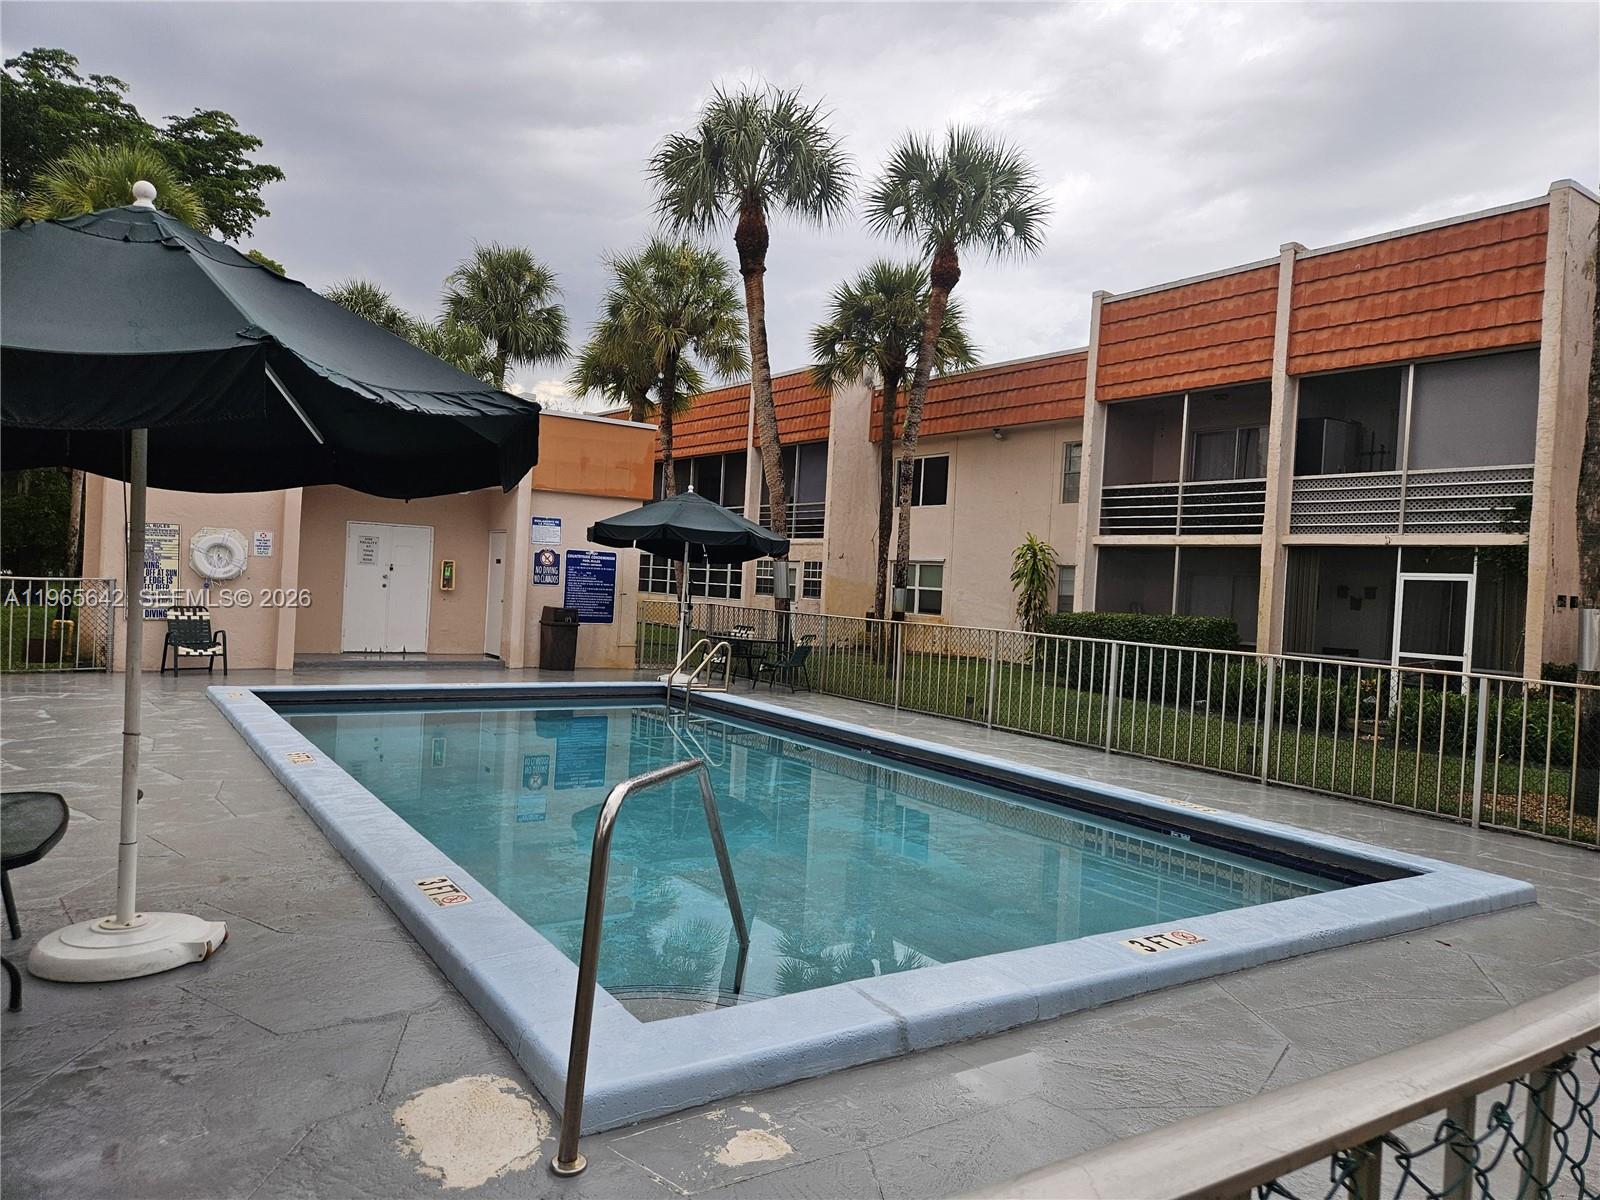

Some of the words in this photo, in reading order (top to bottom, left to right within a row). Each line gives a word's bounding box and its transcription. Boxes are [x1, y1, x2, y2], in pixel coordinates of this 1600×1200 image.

[144, 561, 162, 569] NING:
[146, 569, 156, 577] OFF
[157, 569, 164, 577] AT
[165, 569, 177, 577] SUN
[534, 565, 542, 574] NO
[543, 566, 559, 575] DIVING
[149, 576, 165, 584] EDGE
[166, 576, 173, 585] IS
[534, 574, 540, 583] NO
[145, 609, 168, 618] DIVING
[418, 878, 448, 886] 3
[423, 884, 461, 897] FT
[1128, 939, 1157, 953] 3
[1144, 934, 1183, 950] FT
